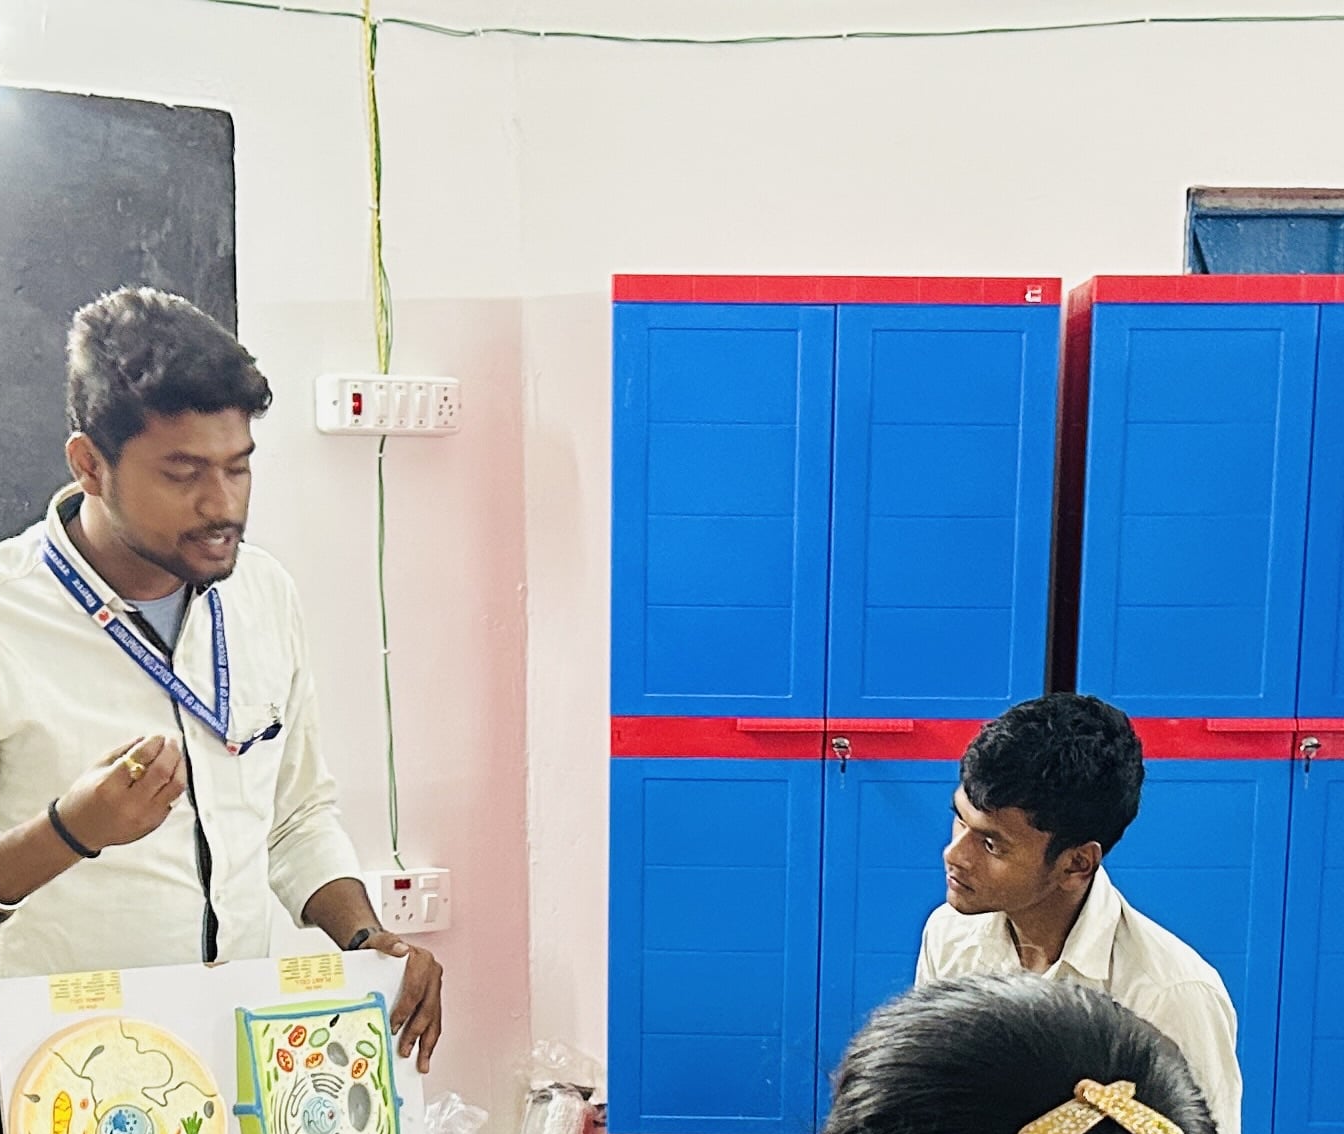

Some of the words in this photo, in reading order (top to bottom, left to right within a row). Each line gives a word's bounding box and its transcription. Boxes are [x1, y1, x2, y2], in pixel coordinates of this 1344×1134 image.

[109, 622, 146, 659] DEPARTMENT
[141, 654, 173, 685] EDUCATION
[170, 678, 189, 699] BIHAR
[184, 695, 195, 706] OF
